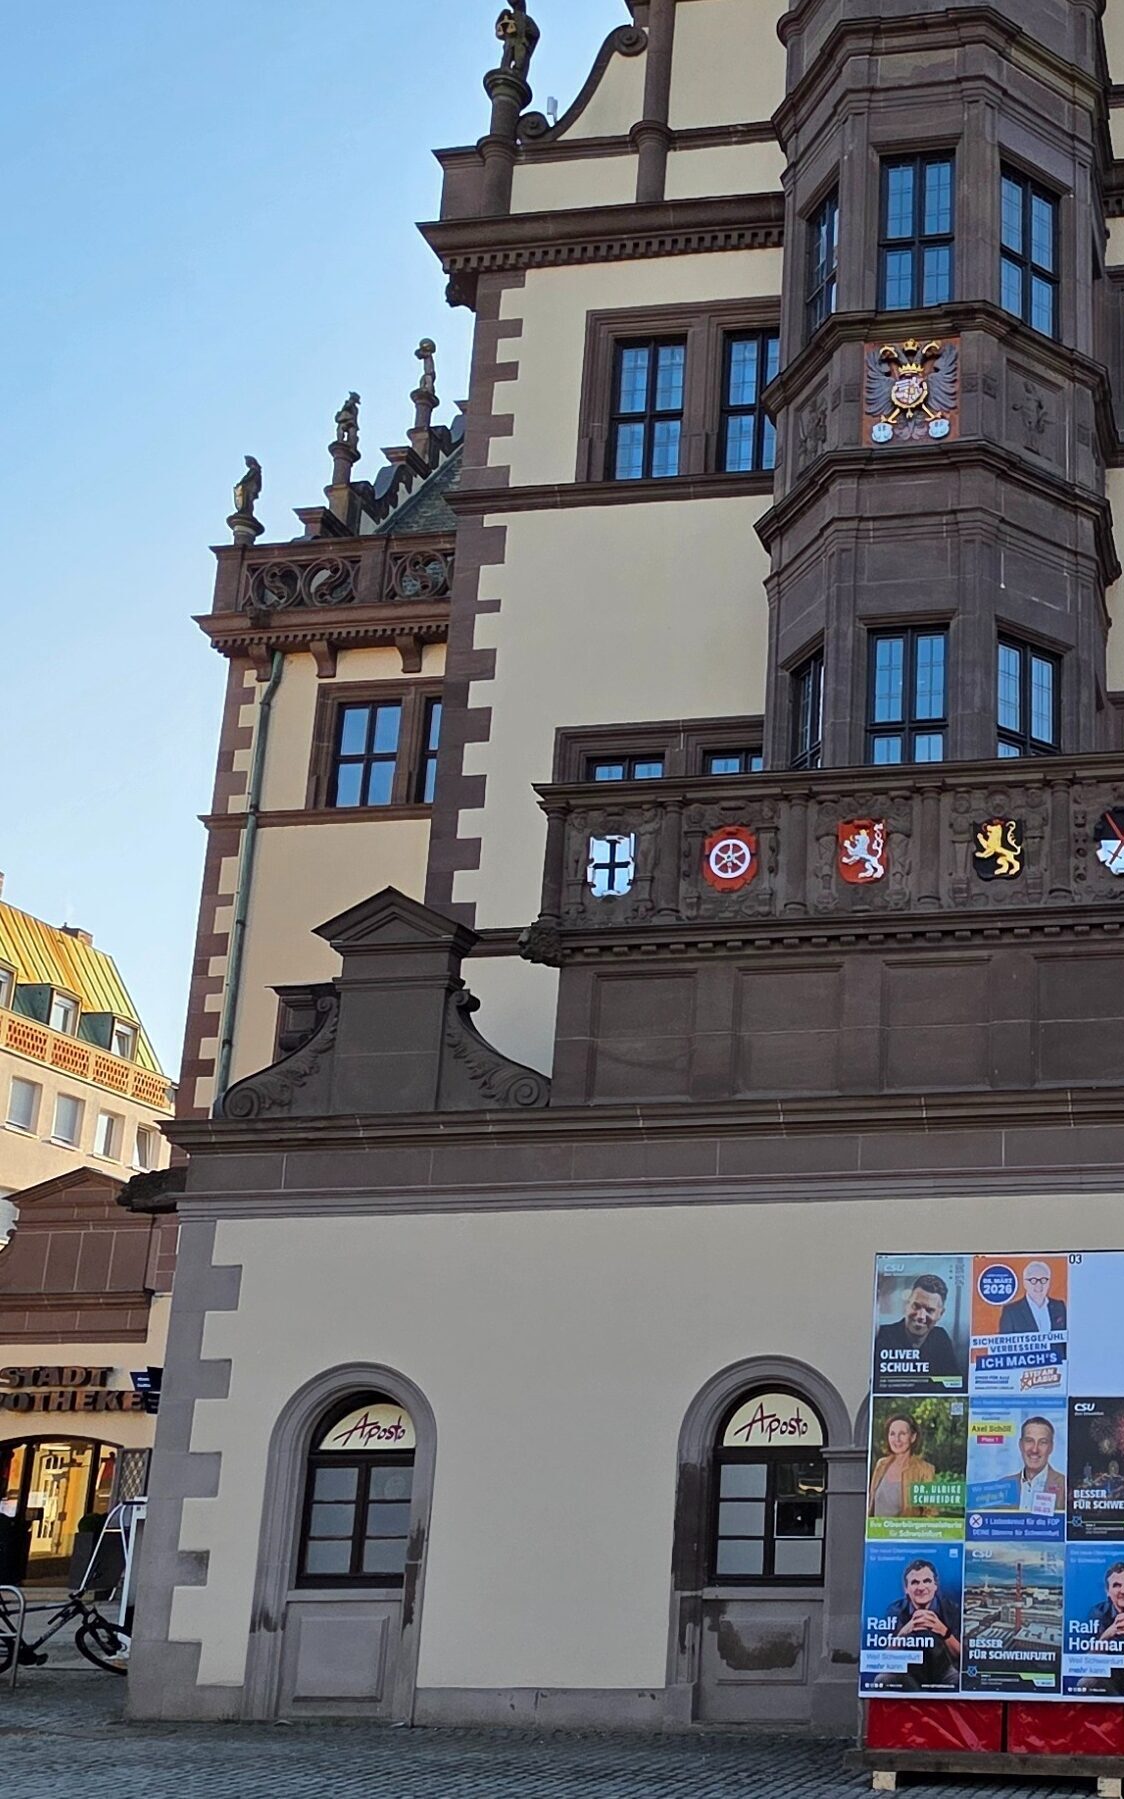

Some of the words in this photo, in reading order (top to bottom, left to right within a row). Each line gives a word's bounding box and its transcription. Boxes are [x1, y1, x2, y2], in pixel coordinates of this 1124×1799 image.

[1069, 1254, 1082, 1264] 03
[884, 1264, 904, 1272] CSU
[983, 1284, 1012, 1294] 2026
[972, 1332, 1064, 1346] SICHERHEITSGEFÜHL
[990, 1343, 1048, 1352] VERBESSERN
[880, 1350, 920, 1360] OLIVER
[982, 1358, 1004, 1368] ICH
[1006, 1353, 1058, 1366] MACH'S
[880, 1362, 930, 1372] SCHULTE
[0, 1366, 113, 1387] STADT
[0, 1391, 144, 1412] OTHEKE
[1074, 1403, 1095, 1412] CSU
[734, 1402, 808, 1442] Aposto
[332, 1411, 406, 1447] Aposto
[914, 1484, 928, 1494] DR.
[932, 1484, 960, 1494] ULRIKE
[1074, 1490, 1106, 1498] BESSER
[914, 1495, 960, 1504] SCHNEIDER
[1074, 1500, 1091, 1510] FÜR
[972, 1550, 992, 1558] CSU
[867, 1616, 897, 1630] Ralf
[1069, 1620, 1100, 1634] Ralf
[866, 1634, 935, 1648] Hofmann
[968, 1639, 1002, 1648] BESSER
[968, 1650, 986, 1660] FÜR
[988, 1650, 1056, 1661] SCHWEINFURT!
